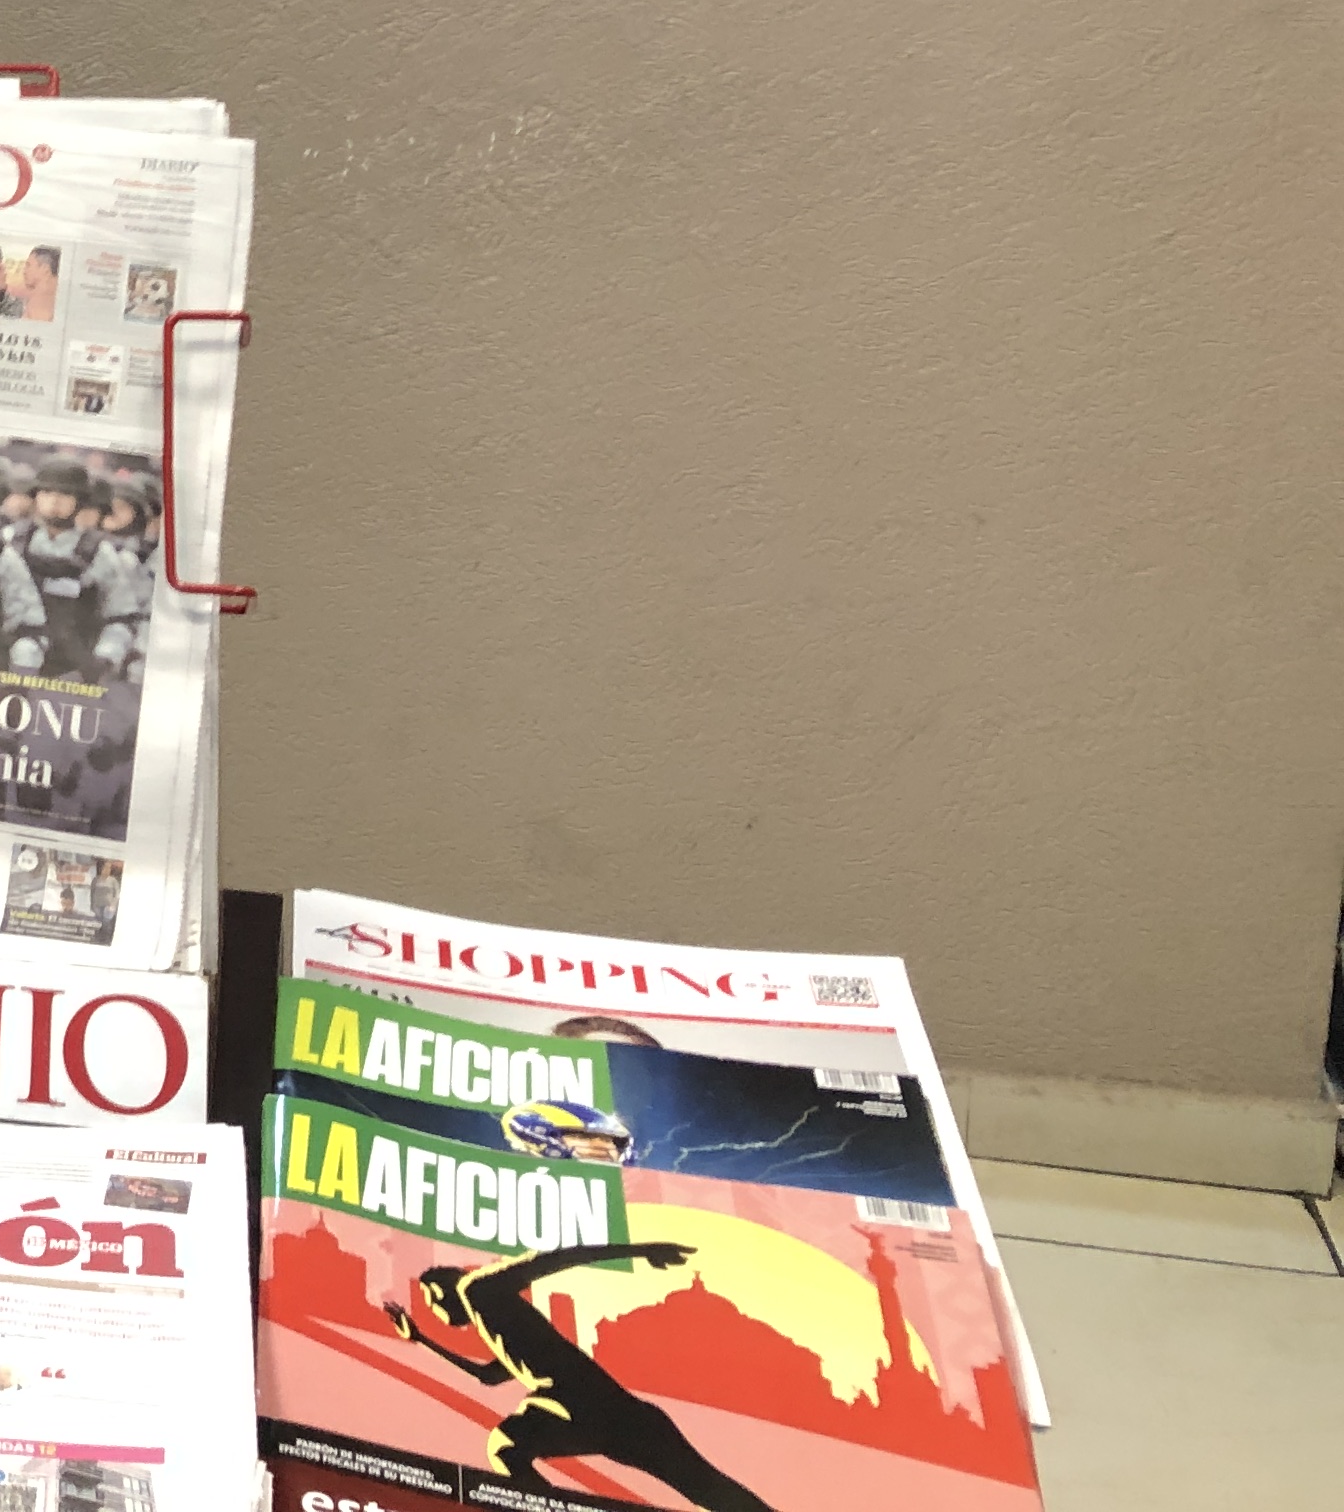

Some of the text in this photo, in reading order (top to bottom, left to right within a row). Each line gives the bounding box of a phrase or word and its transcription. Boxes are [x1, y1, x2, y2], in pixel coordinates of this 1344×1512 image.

[346, 922, 780, 1002] SHOPPING
[291, 996, 595, 1110] LA AFICIÓN
[131, 1150, 198, 1164] Cultural
[285, 1112, 609, 1252] LA AFICIÓN
[278, 1443, 320, 1463] EFECTOS
[322, 1454, 366, 1473] FISCALES
[368, 1465, 382, 1478] DE
[383, 1469, 398, 1482] SU
[295, 1437, 435, 1481] PADRÓN DE IMPORTADORES:
[478, 1483, 522, 1501] AMPARO
[524, 1493, 546, 1507] QUE
[549, 1497, 565, 1509] DA
